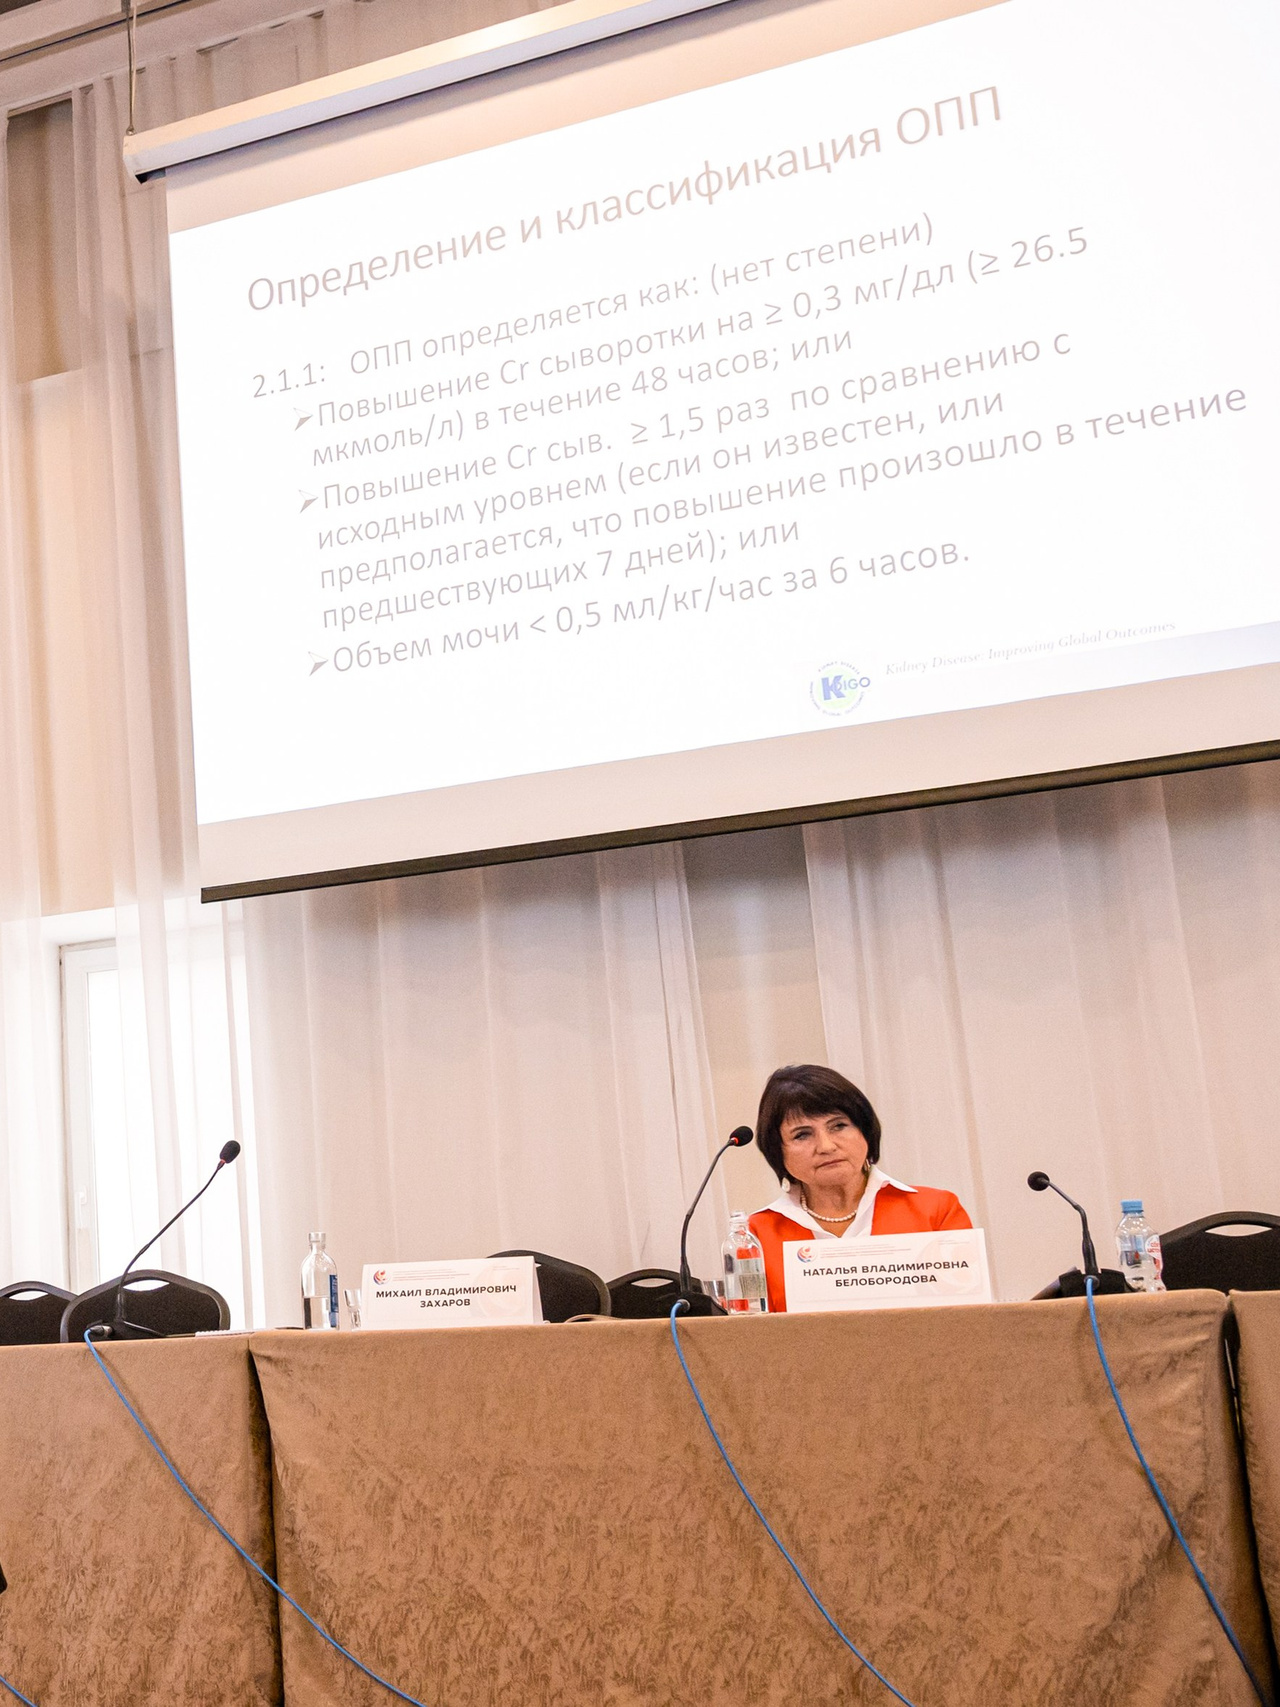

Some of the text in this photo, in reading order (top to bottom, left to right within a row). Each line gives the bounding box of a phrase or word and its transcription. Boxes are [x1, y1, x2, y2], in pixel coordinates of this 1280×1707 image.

[247, 85, 1002, 311] Определение и классификация ОПП
[252, 211, 933, 399] 2.1.1: ОПП определяется как: (нет степени)
[318, 371, 490, 427] Повышение
[499, 359, 530, 385] Cr
[539, 321, 705, 377] сыворотки
[717, 310, 754, 337] на
[792, 284, 842, 320] 0,3
[854, 263, 955, 306] мг/дл
[1010, 226, 1088, 269] 26.5
[313, 330, 852, 467] мкмоль/л) в течение 48 часов; или
[323, 455, 497, 510] Повышение
[506, 444, 538, 470] Cr
[547, 433, 612, 462] сыв.
[659, 405, 705, 441] 1,5
[716, 397, 770, 434] раз
[790, 385, 830, 412] по
[841, 339, 1041, 405] сравнению
[1053, 333, 1071, 356] с
[318, 392, 1004, 550] исходным уровнем (если он известен, или
[320, 388, 1247, 593] предполагается, что повышение произошло в течение
[323, 520, 799, 633] предшествующих 7 дней); или
[333, 542, 969, 673] Объем мочи < 0,5 мл/кг/час за 6 часов.
[376, 1285, 516, 1298] МИХАИЛ ВЛАДИМИРОВИЧ
[420, 1299, 470, 1308] ЗАХАРОВ
[803, 1261, 968, 1276] НАТАЛЬЯ ВЛАДИМИРОВНА
[836, 1275, 937, 1287] БЕЛОБОРОДОВА
